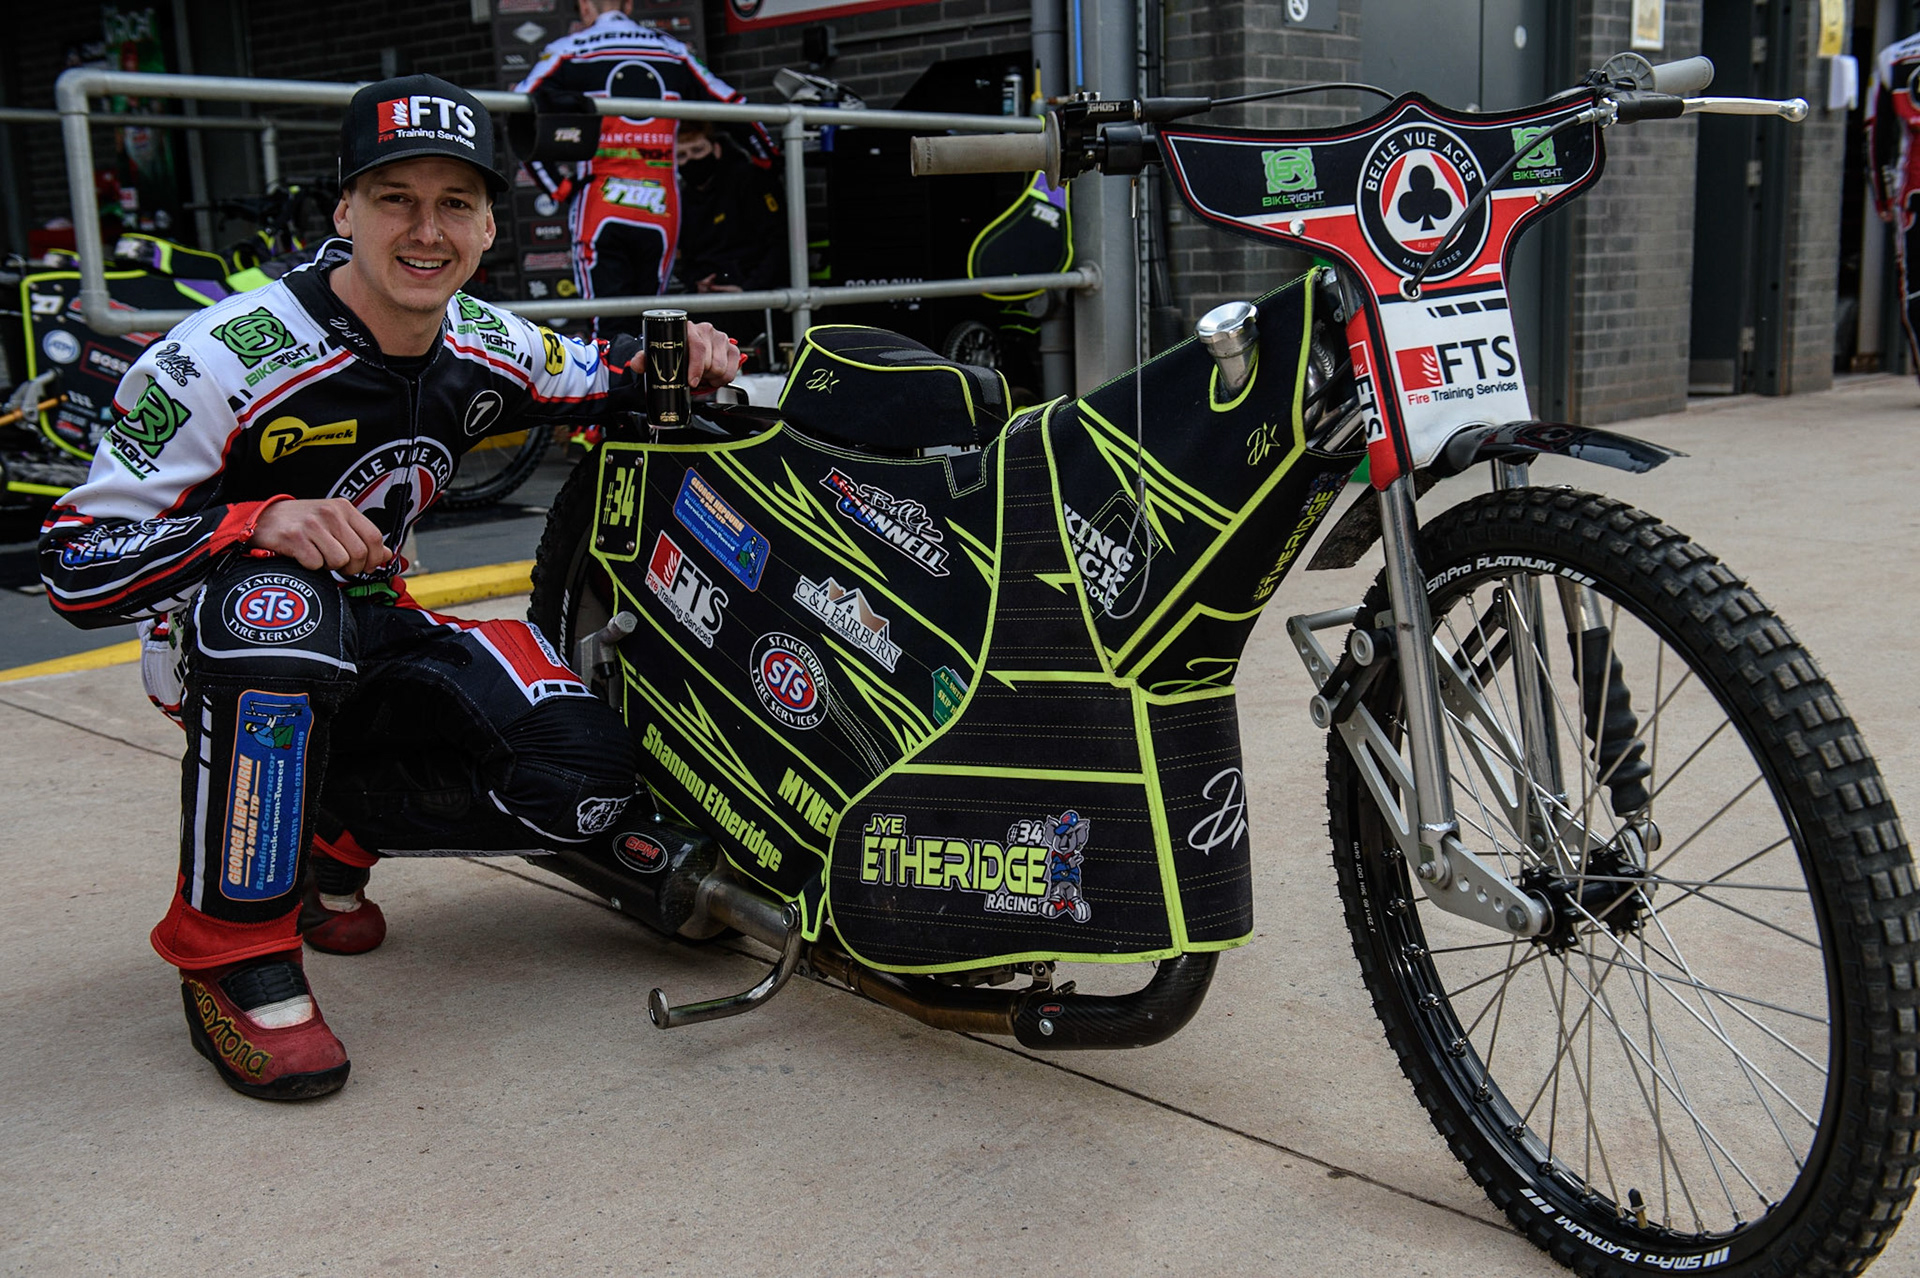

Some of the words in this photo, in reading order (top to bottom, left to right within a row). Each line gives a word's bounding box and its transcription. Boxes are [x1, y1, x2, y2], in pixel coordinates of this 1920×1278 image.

[409, 95, 477, 138] FTS
[1089, 102, 1121, 113] GHOST
[378, 133, 395, 143] Fire
[396, 128, 436, 139] Training
[437, 130, 475, 150] Services
[1365, 140, 1400, 192] BELLE
[1403, 131, 1438, 147] VUE
[1442, 142, 1477, 183] ACES
[1262, 190, 1325, 207] BIKERIGHT
[649, 341, 684, 350] RICH
[1435, 334, 1517, 385] FTS
[1406, 393, 1430, 406] Fire
[1433, 386, 1474, 402] Training
[1475, 381, 1519, 396] Services
[340, 459, 386, 500] ELLE
[394, 446, 430, 465] VUE
[602, 466, 635, 528] #34
[690, 476, 716, 504] GEORGE
[712, 499, 745, 533] HEPBURN
[1257, 490, 1335, 600] ETHERIDGE
[1476, 555, 1557, 573] PLATINUM
[236, 576, 314, 598] STAKEFORD
[246, 590, 296, 623] STS
[646, 573, 659, 592] Fire
[659, 585, 684, 620] Training
[682, 612, 713, 646] Services
[670, 554, 728, 632] FTS
[228, 617, 257, 640] TYRE
[258, 618, 317, 642] SERVICES
[796, 581, 810, 599] C
[808, 593, 822, 612] &
[818, 600, 831, 618] L
[829, 606, 900, 666] FAIRBURN
[826, 618, 862, 648] PROPERTIES
[766, 656, 809, 703] STS
[768, 635, 826, 688] STAKEFORD
[752, 667, 771, 703] TYRE
[768, 699, 819, 727] SERVICES
[641, 722, 707, 804] Shannon
[231, 753, 254, 830] HEPBURN
[249, 794, 261, 820] LTD
[261, 752, 277, 833] Contractor
[247, 820, 259, 848] SON
[266, 759, 285, 883] Berwick-upon-Tweed
[701, 782, 783, 873] Etheridge
[865, 816, 904, 835] JYE
[1009, 822, 1043, 845] #34
[227, 828, 247, 886] GEORGE
[255, 834, 270, 891] Building
[861, 835, 1048, 897] ETHERIDGE
[986, 893, 1039, 914] RACING
[1553, 1214, 1640, 1264] PLATINUM
